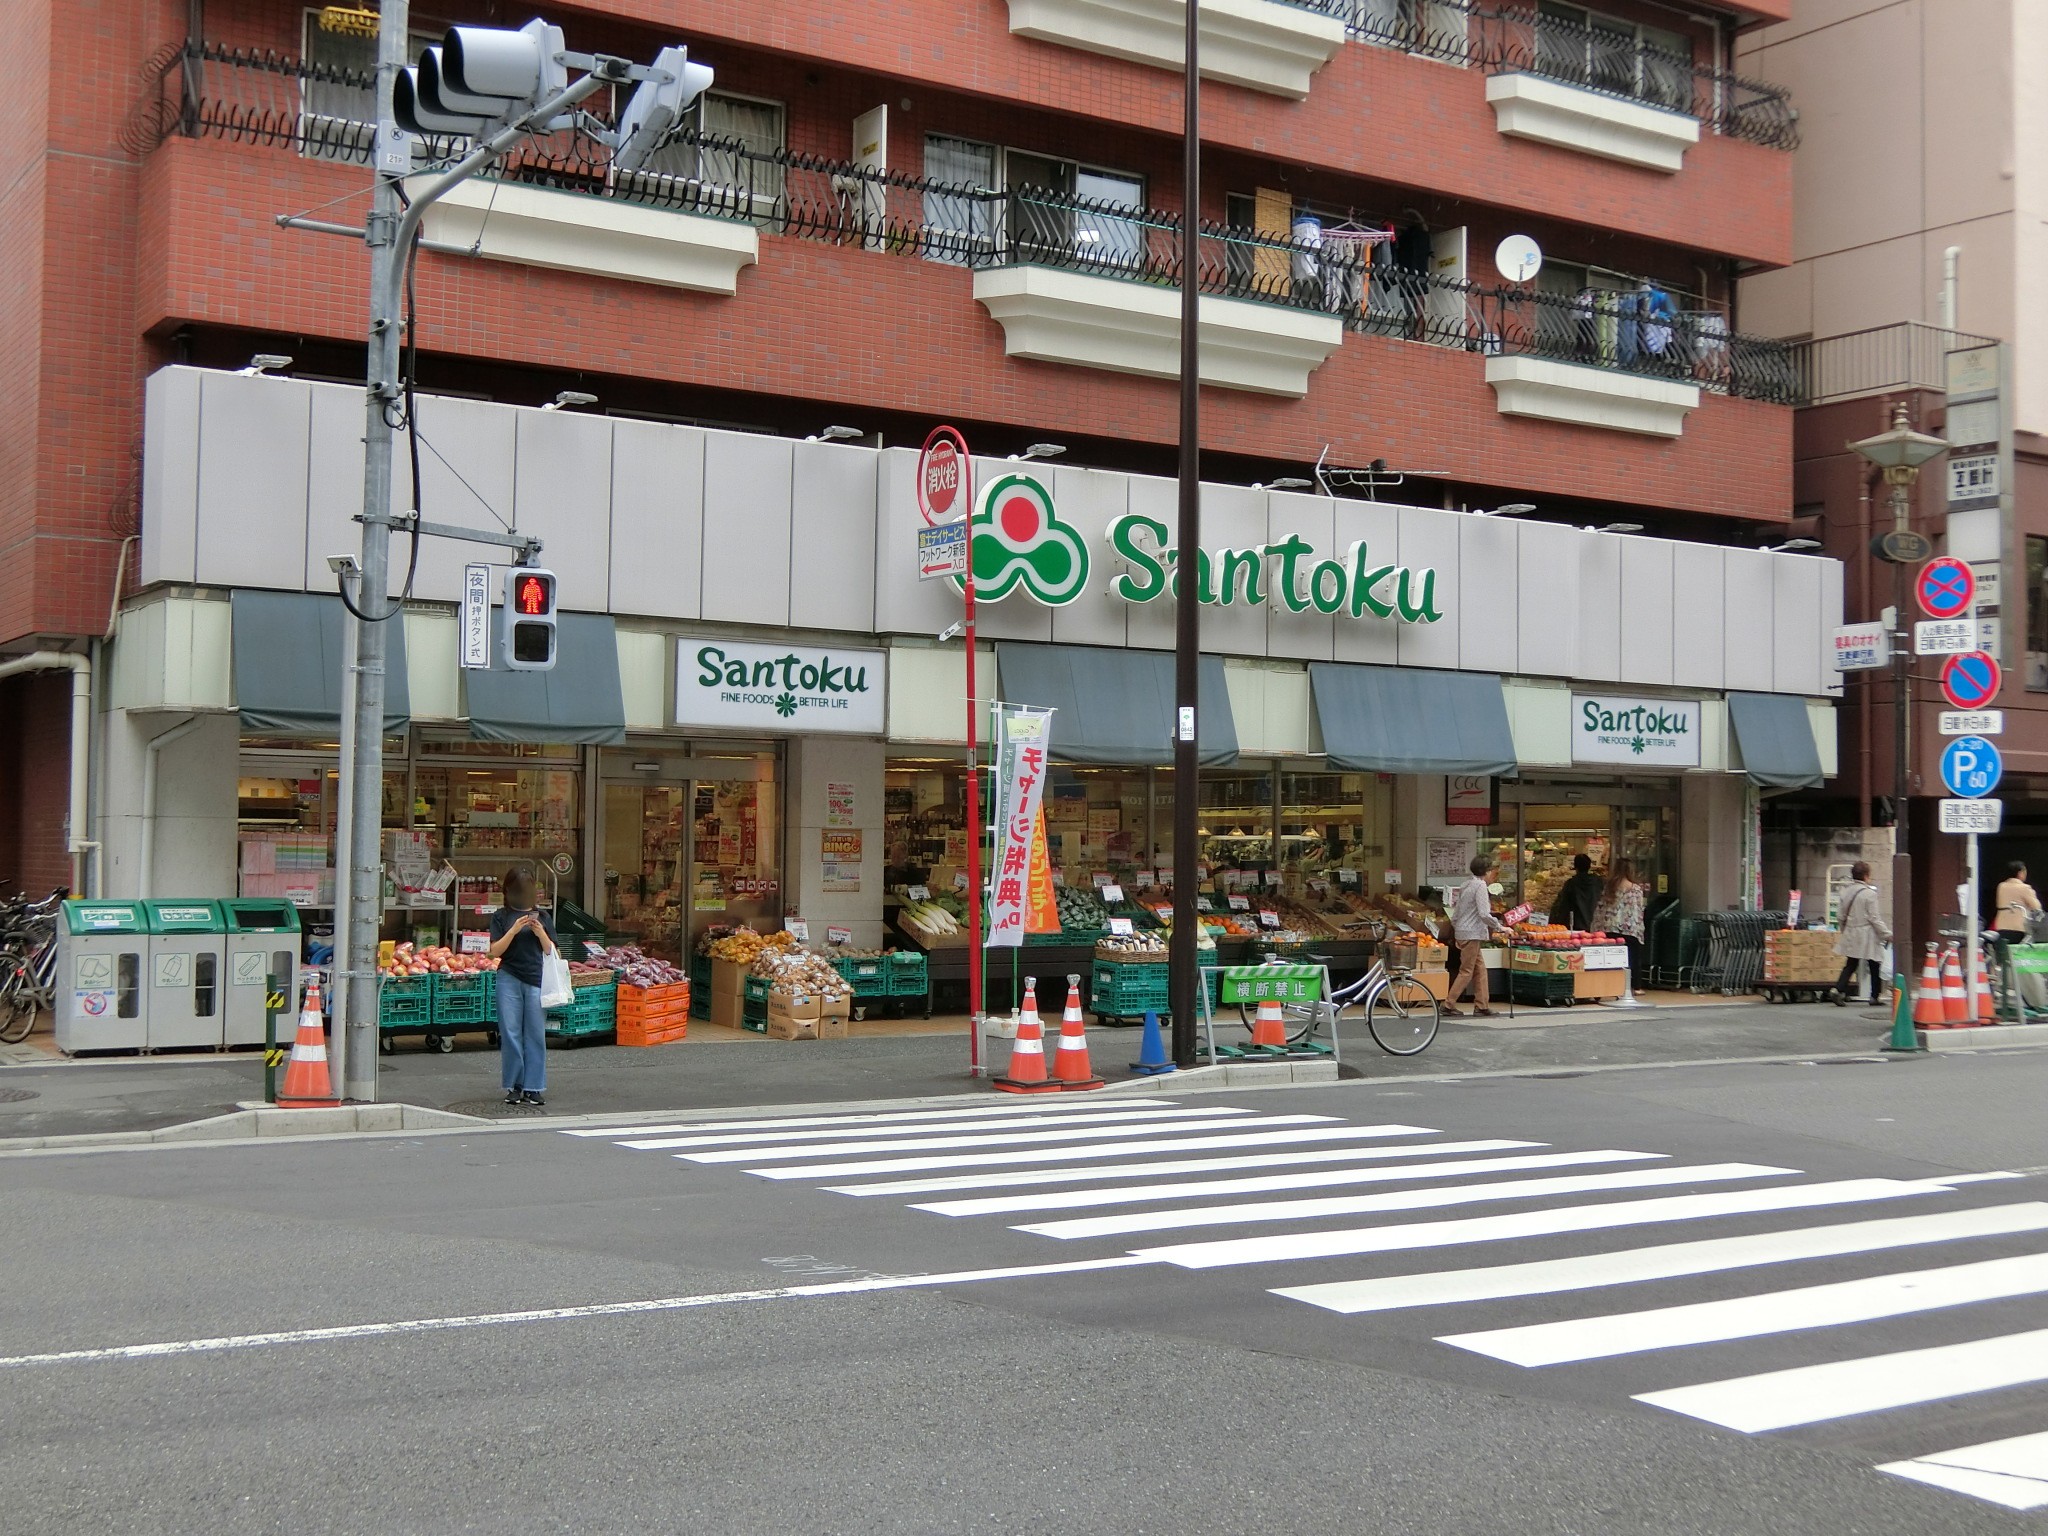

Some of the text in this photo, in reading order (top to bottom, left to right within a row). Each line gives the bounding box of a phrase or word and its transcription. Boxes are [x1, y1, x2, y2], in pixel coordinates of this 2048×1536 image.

[928, 461, 957, 495] 消火栓
[919, 525, 966, 549] 富士デイサービス
[920, 542, 966, 563] フットワーク新宿
[952, 557, 965, 570] 入口
[1105, 513, 1444, 624] Santoku
[469, 571, 485, 658] 夜間押ボタン式
[697, 646, 869, 693] Santoku
[721, 692, 848, 709] FINE FOODS BETTER LIFE
[1583, 700, 1689, 735] Santoku
[1598, 735, 1676, 747] FINE FOODS BETTER LIFE
[1953, 750, 1978, 788] P
[1968, 771, 1988, 788] 60
[1454, 775, 1486, 790] CGC
[823, 842, 860, 853] BINGO
[1237, 981, 1306, 997] 横断禁止
